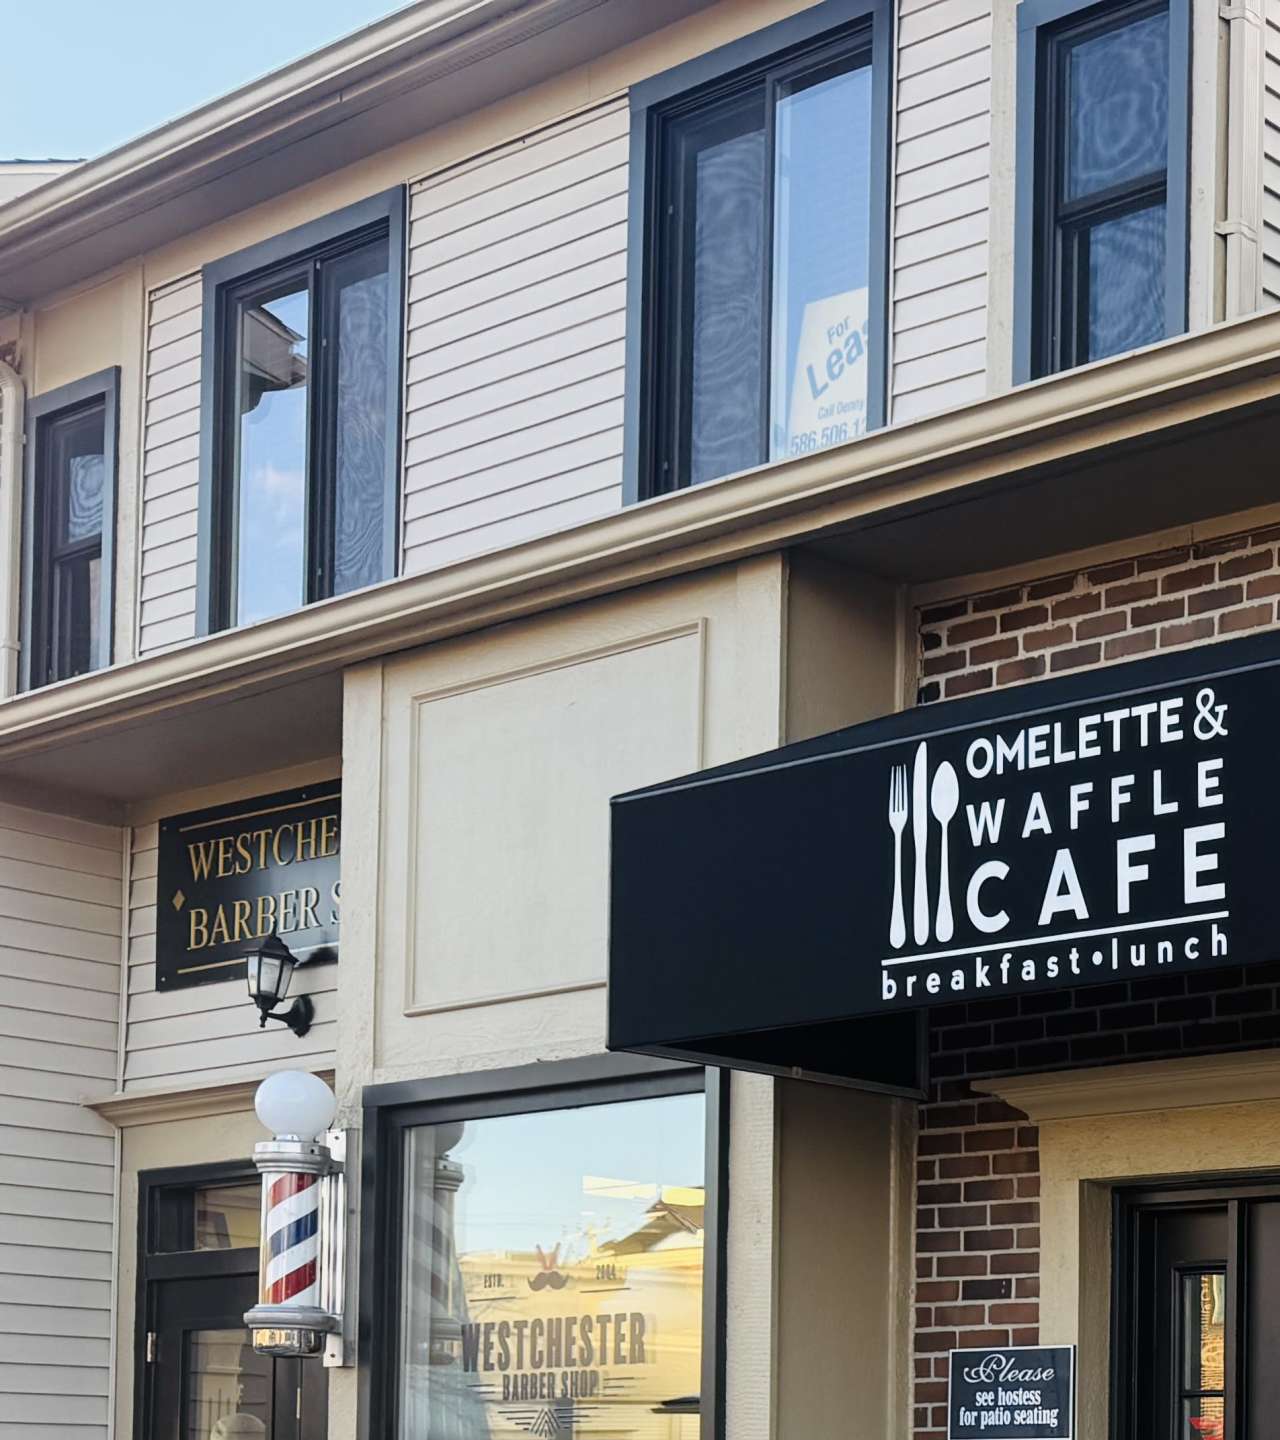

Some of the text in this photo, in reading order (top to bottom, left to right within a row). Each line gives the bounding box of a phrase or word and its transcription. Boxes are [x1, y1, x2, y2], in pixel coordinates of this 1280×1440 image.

[806, 320, 868, 400] Lea
[827, 315, 850, 344] For
[790, 417, 866, 457] 586.506.1
[966, 687, 1228, 779] OMELETTE &
[966, 758, 1224, 847] WAFFLE
[187, 815, 339, 882] WESTCHE
[966, 822, 1226, 933] CAFE
[186, 887, 322, 951] BARBER
[461, 1312, 646, 1373] WESTCHESTER
[963, 1354, 1055, 1383] Please
[502, 1370, 600, 1401] BARBER SHOP
[976, 1387, 1041, 1406] see hostess
[959, 1406, 1059, 1429] for patio seating
